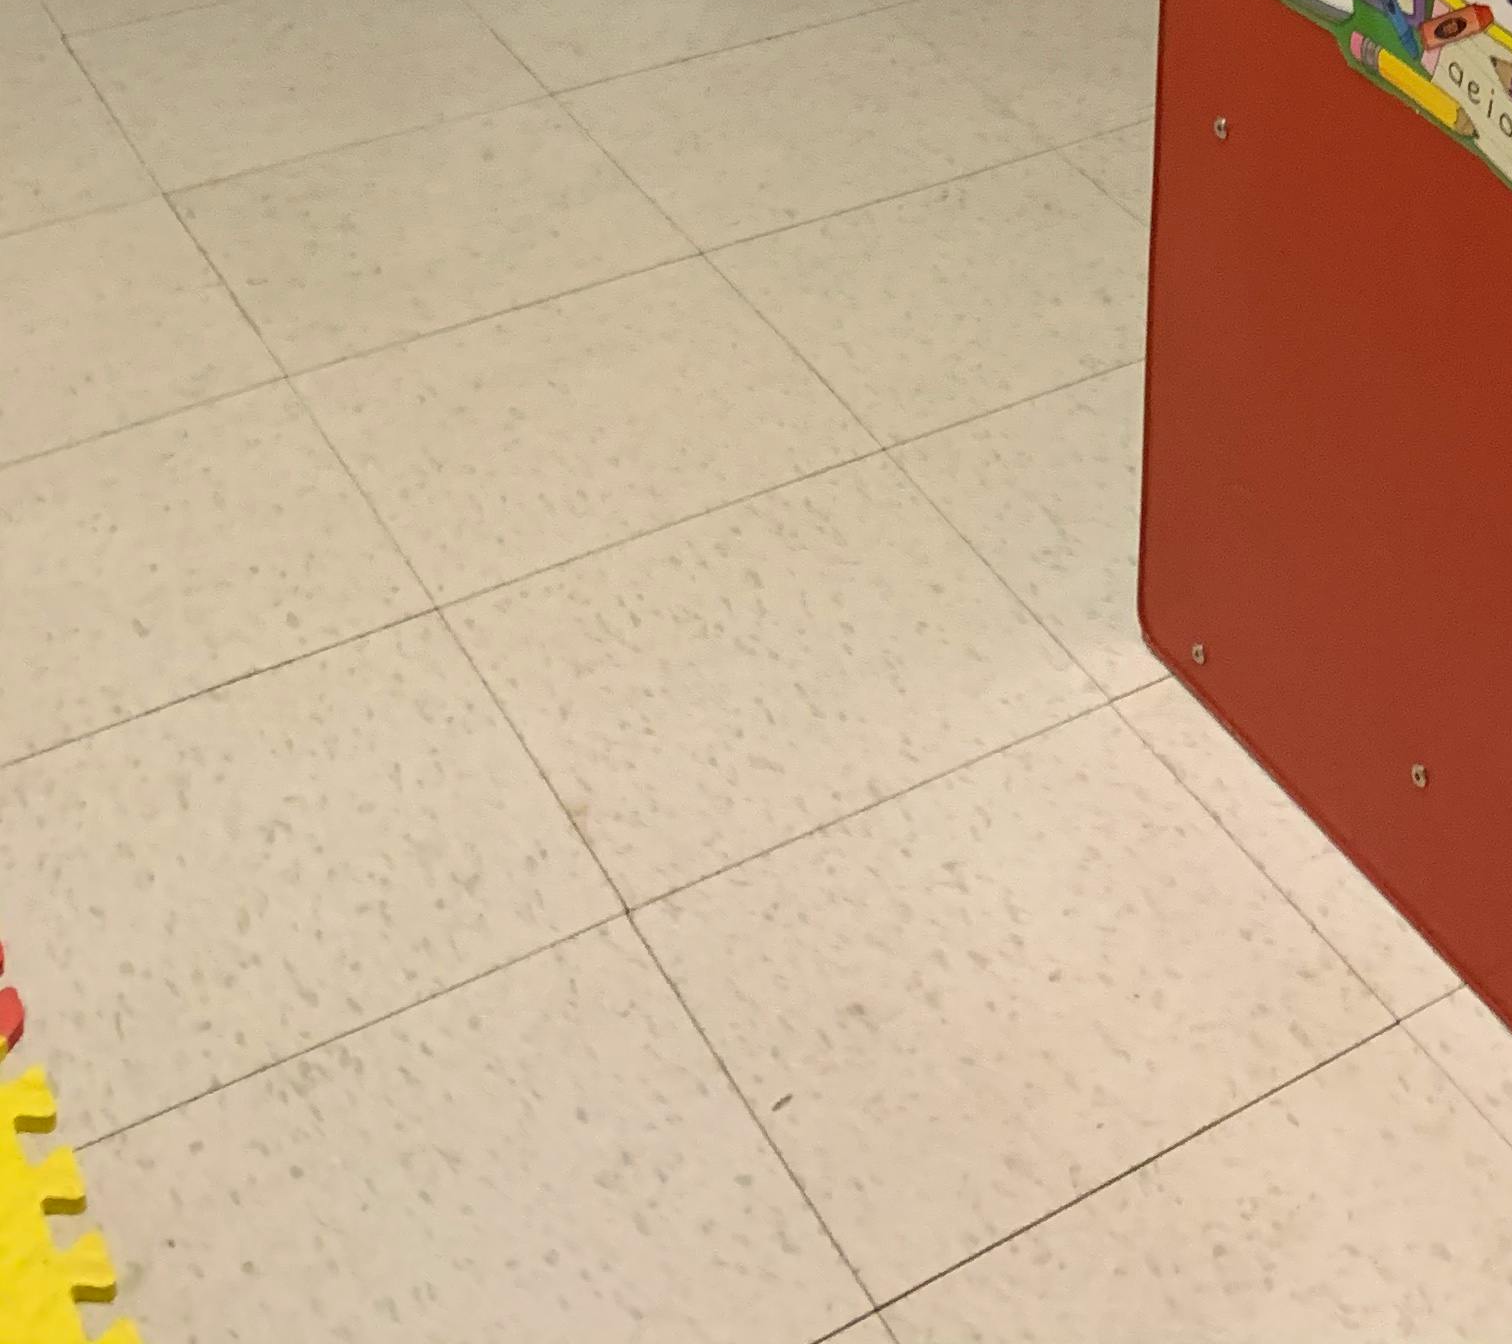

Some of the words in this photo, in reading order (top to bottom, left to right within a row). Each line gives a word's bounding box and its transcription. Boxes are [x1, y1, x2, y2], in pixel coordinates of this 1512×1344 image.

[1448, 61, 1464, 90] a
[1467, 82, 1480, 106] e
[1487, 89, 1496, 119] i
